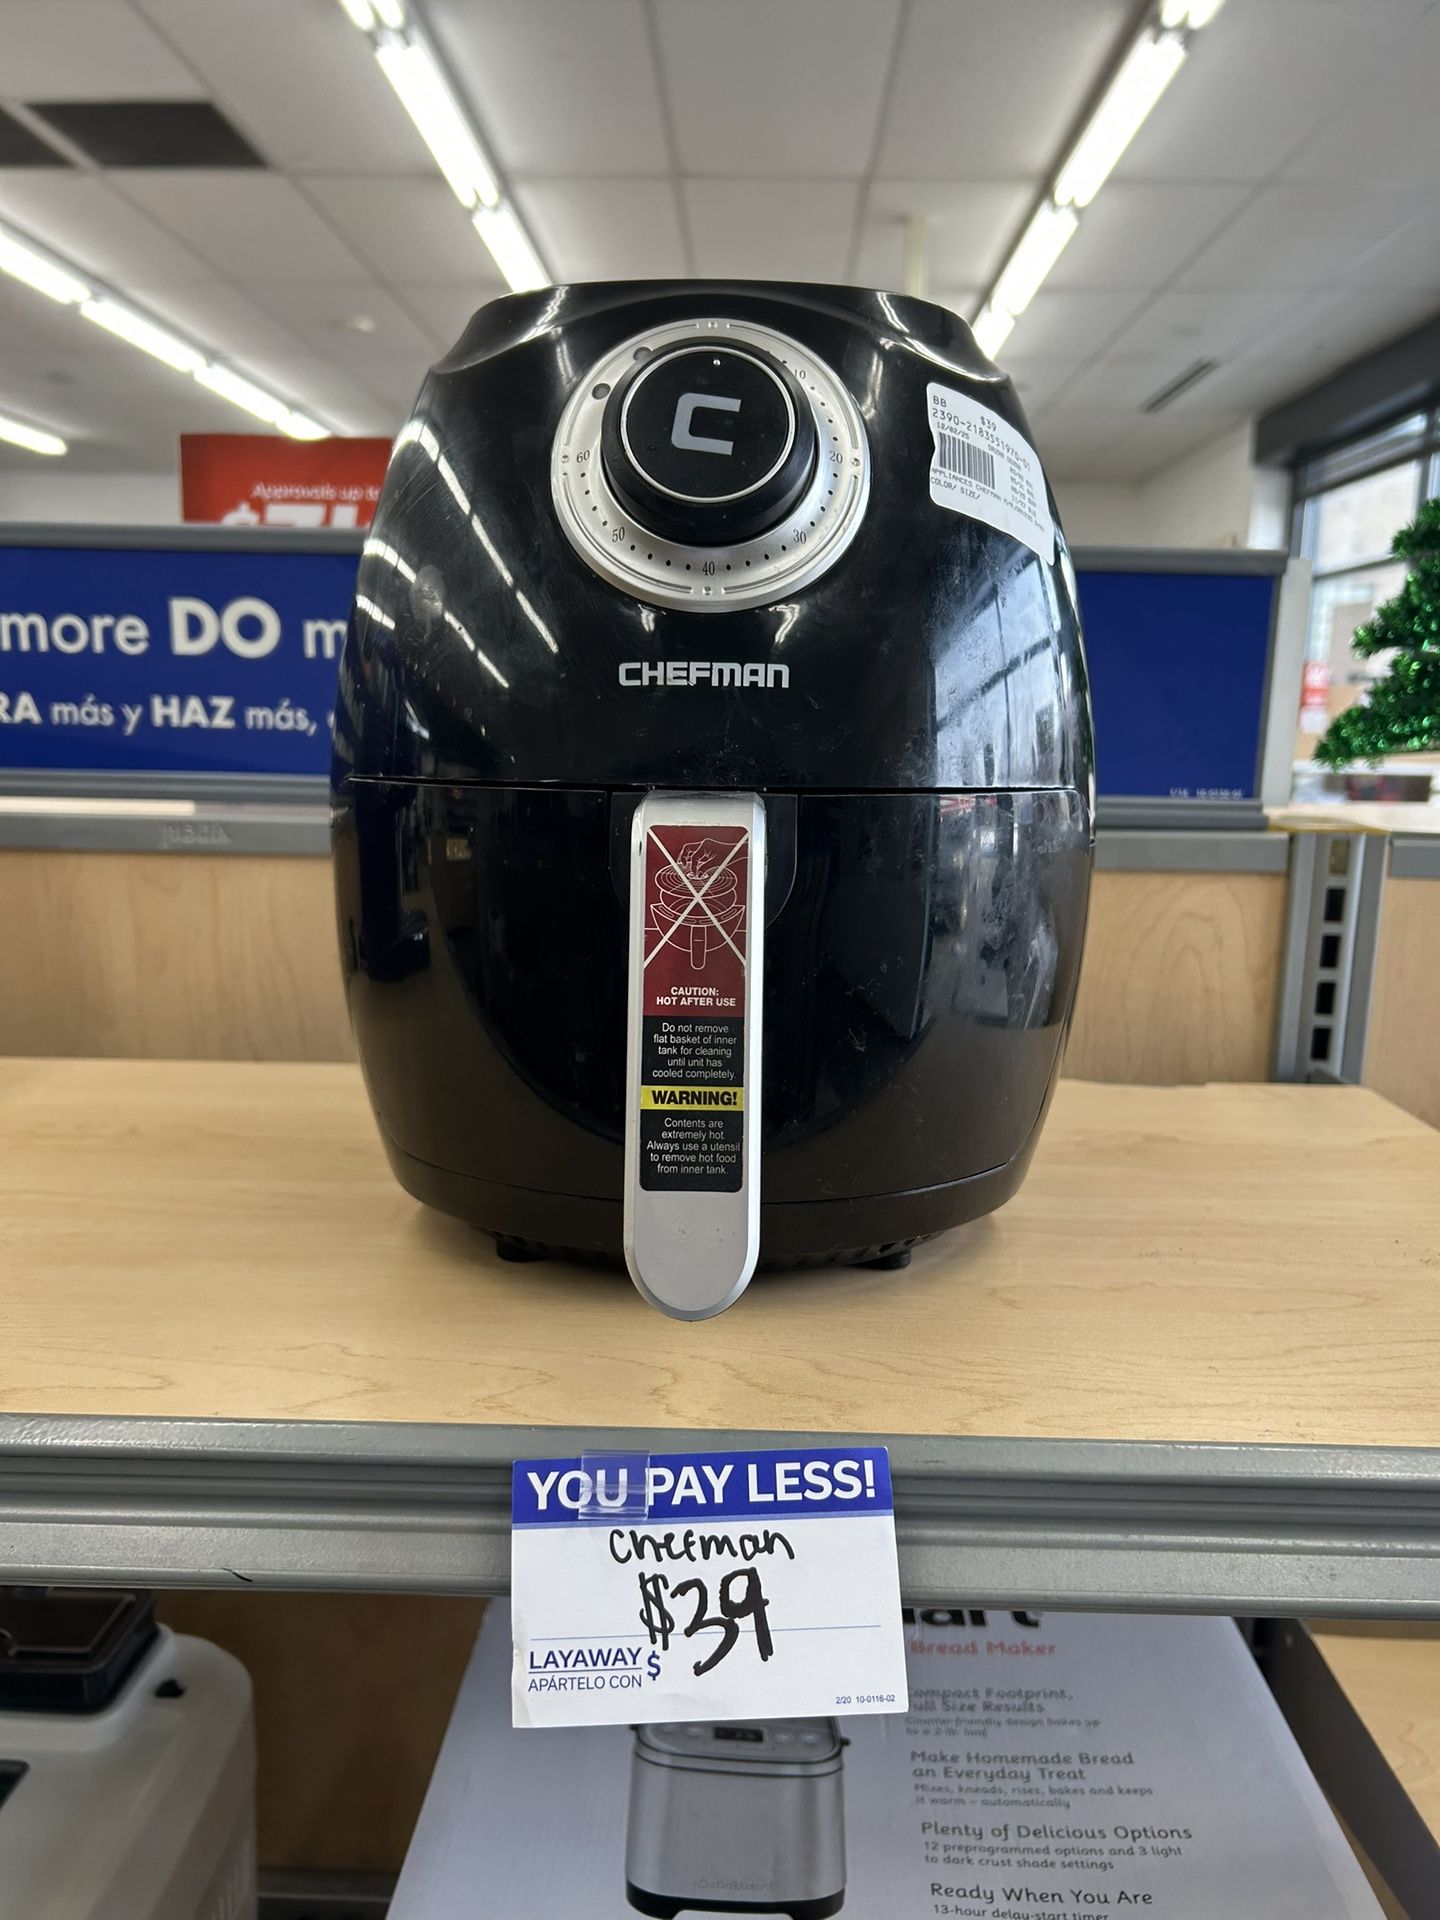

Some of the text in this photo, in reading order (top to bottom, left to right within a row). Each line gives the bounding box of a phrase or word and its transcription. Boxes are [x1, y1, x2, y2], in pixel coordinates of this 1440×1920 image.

[933, 395, 947, 408] BB
[980, 416, 997, 431] $39
[576, 449, 591, 464] 60
[828, 449, 844, 465] 20
[611, 527, 626, 543] 50
[793, 529, 808, 545] 30
[702, 561, 716, 576] 40
[0, 612, 150, 656] more
[168, 596, 282, 660] DO
[618, 661, 790, 689] CHEFMAN
[51, 692, 116, 727] más
[122, 703, 143, 737] y
[150, 694, 236, 730] HAZ
[670, 986, 720, 996] CAUTION:
[656, 996, 737, 1007] HOT AFTER USE
[661, 1022, 729, 1034] Do not remove
[653, 1033, 737, 1045] flat basket of inner
[658, 1045, 732, 1058] tank for cleaning
[667, 1057, 723, 1068] until unit has
[652, 1069, 683, 1078] cooled
[651, 1089, 738, 1106] WARNING!
[664, 1117, 724, 1129] Contents are
[661, 1130, 707, 1141] extremely
[646, 1140, 741, 1152] Always use a utensil
[650, 1152, 737, 1163] to remove hot food
[657, 1163, 679, 1173] from
[680, 1164, 704, 1174] inner
[527, 1459, 876, 1511] YOU PAY LESS!
[639, 1566, 774, 1677] $39
[910, 1640, 1056, 1656] Bread Maker
[529, 1646, 662, 1681] LAYAWAY $
[528, 1674, 643, 1692] APÁRTELO CON
[836, 1694, 896, 1705] 2/20 10-0116-02
[910, 1750, 1135, 1766] Make Homemade Bread
[912, 1766, 1087, 1783] an Everyday Treat
[920, 1821, 1193, 1844] Plenty of Delicious Options
[925, 1841, 1183, 1859] 12 preprogrammed options and 3 light
[924, 1854, 1114, 1872] to dark crust shade settings
[930, 1882, 1153, 1906] Ready When You Are
[933, 1903, 987, 1919] 13-hour
